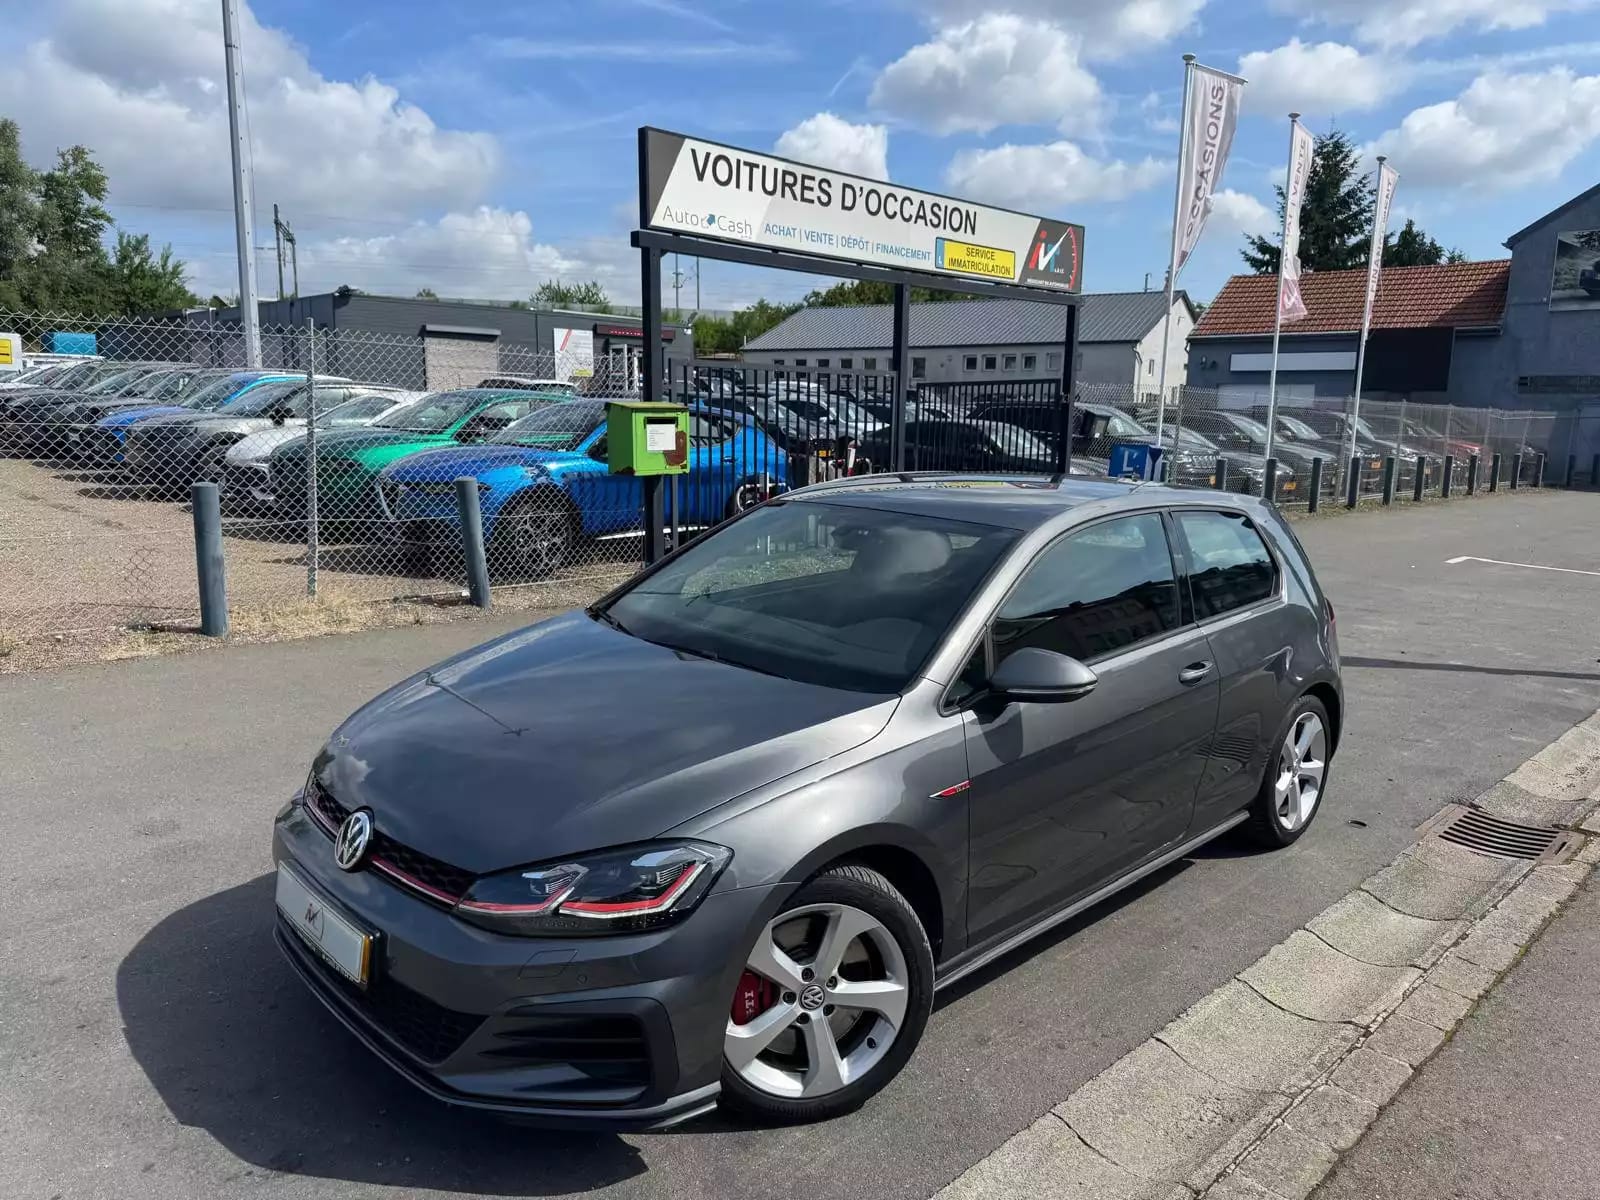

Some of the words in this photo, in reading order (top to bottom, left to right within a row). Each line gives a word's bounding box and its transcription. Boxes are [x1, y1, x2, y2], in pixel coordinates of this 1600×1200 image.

[1186, 85, 1225, 238] OCCASIONS
[690, 147, 832, 207] VOITURES
[840, 182, 977, 236] D'OCCASION
[663, 205, 699, 226] Auto
[717, 215, 753, 236] Cash
[764, 223, 797, 239] ACHAT
[804, 229, 834, 246] VENTE
[841, 234, 870, 250] DÉPÔT
[876, 242, 931, 261] FINANCEMENT
[966, 246, 995, 261] SERVICE
[948, 257, 1010, 276] IMMATRICULATION
